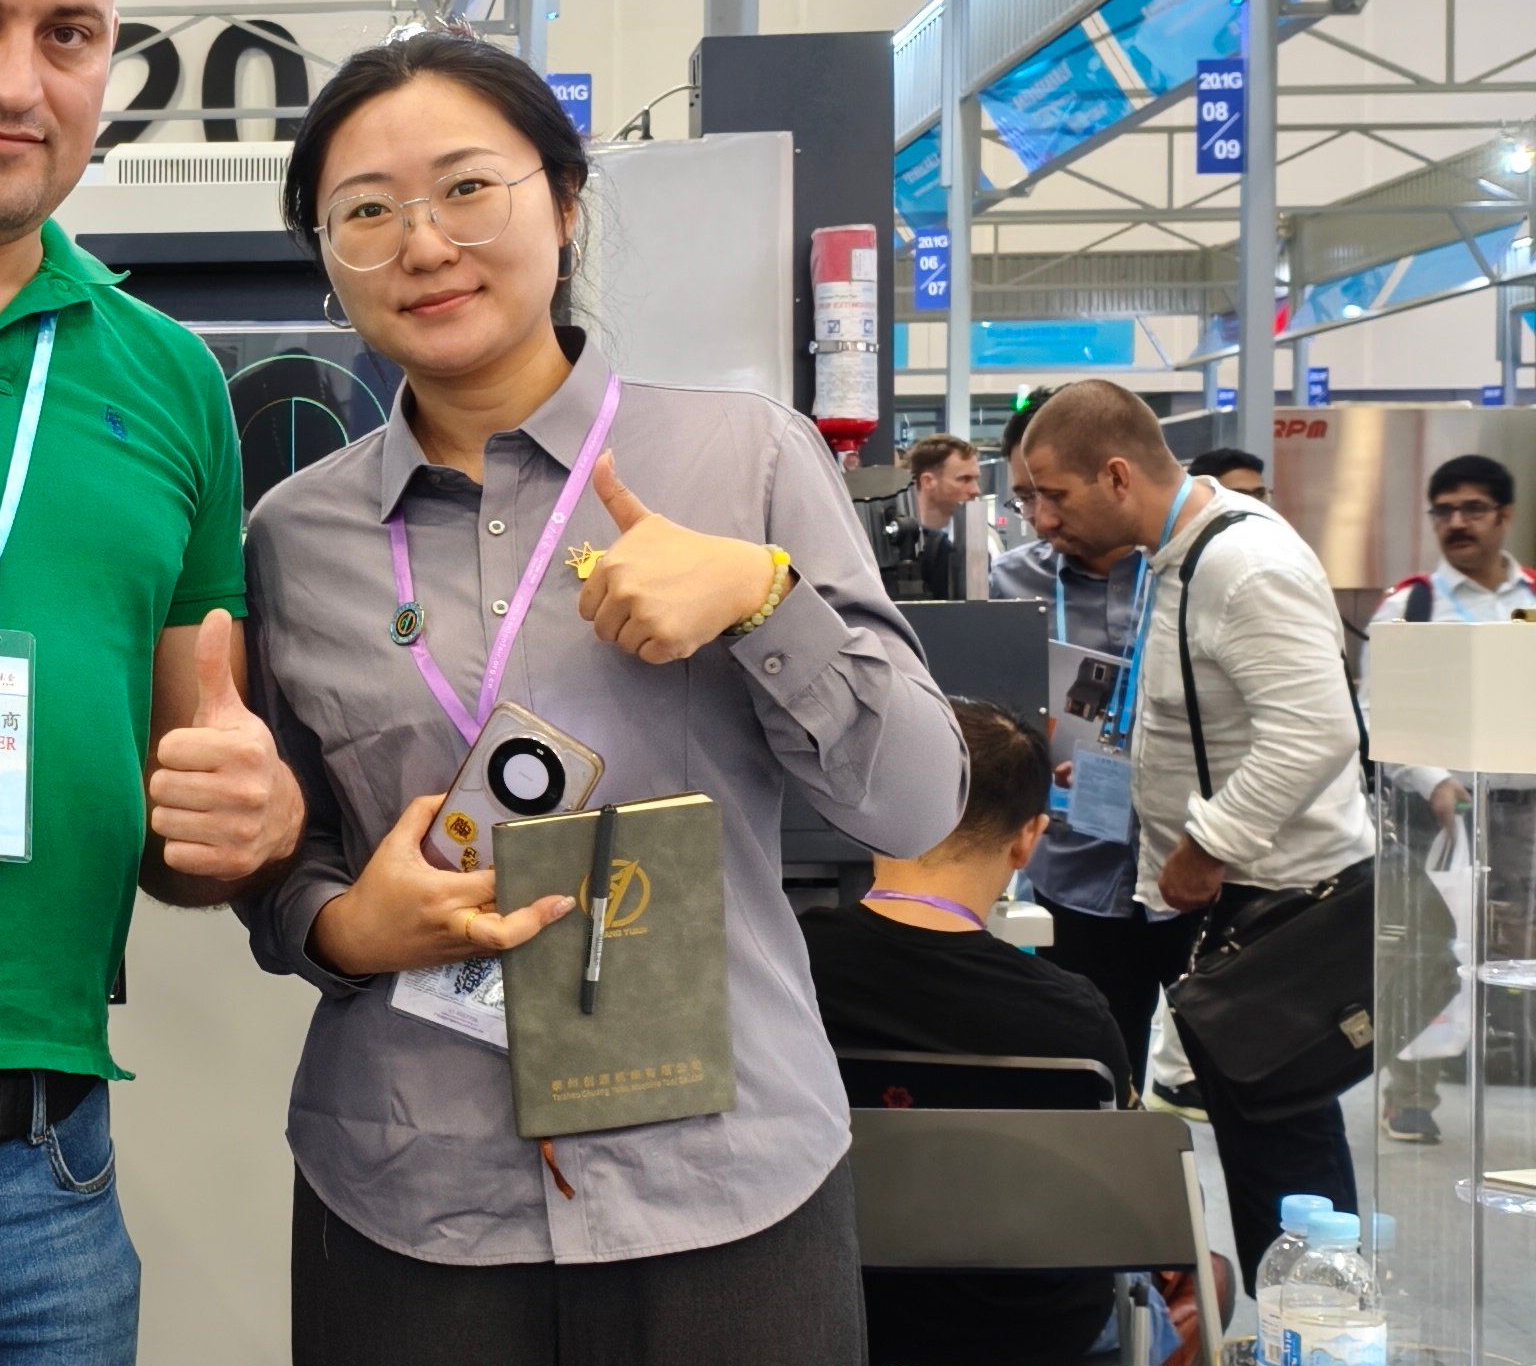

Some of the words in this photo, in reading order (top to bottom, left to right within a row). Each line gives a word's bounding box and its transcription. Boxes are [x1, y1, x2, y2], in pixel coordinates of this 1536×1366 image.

[1202, 100, 1229, 121] 08
[1214, 139, 1241, 159] 09
[920, 257, 938, 271] 06
[928, 282, 948, 296] 07
